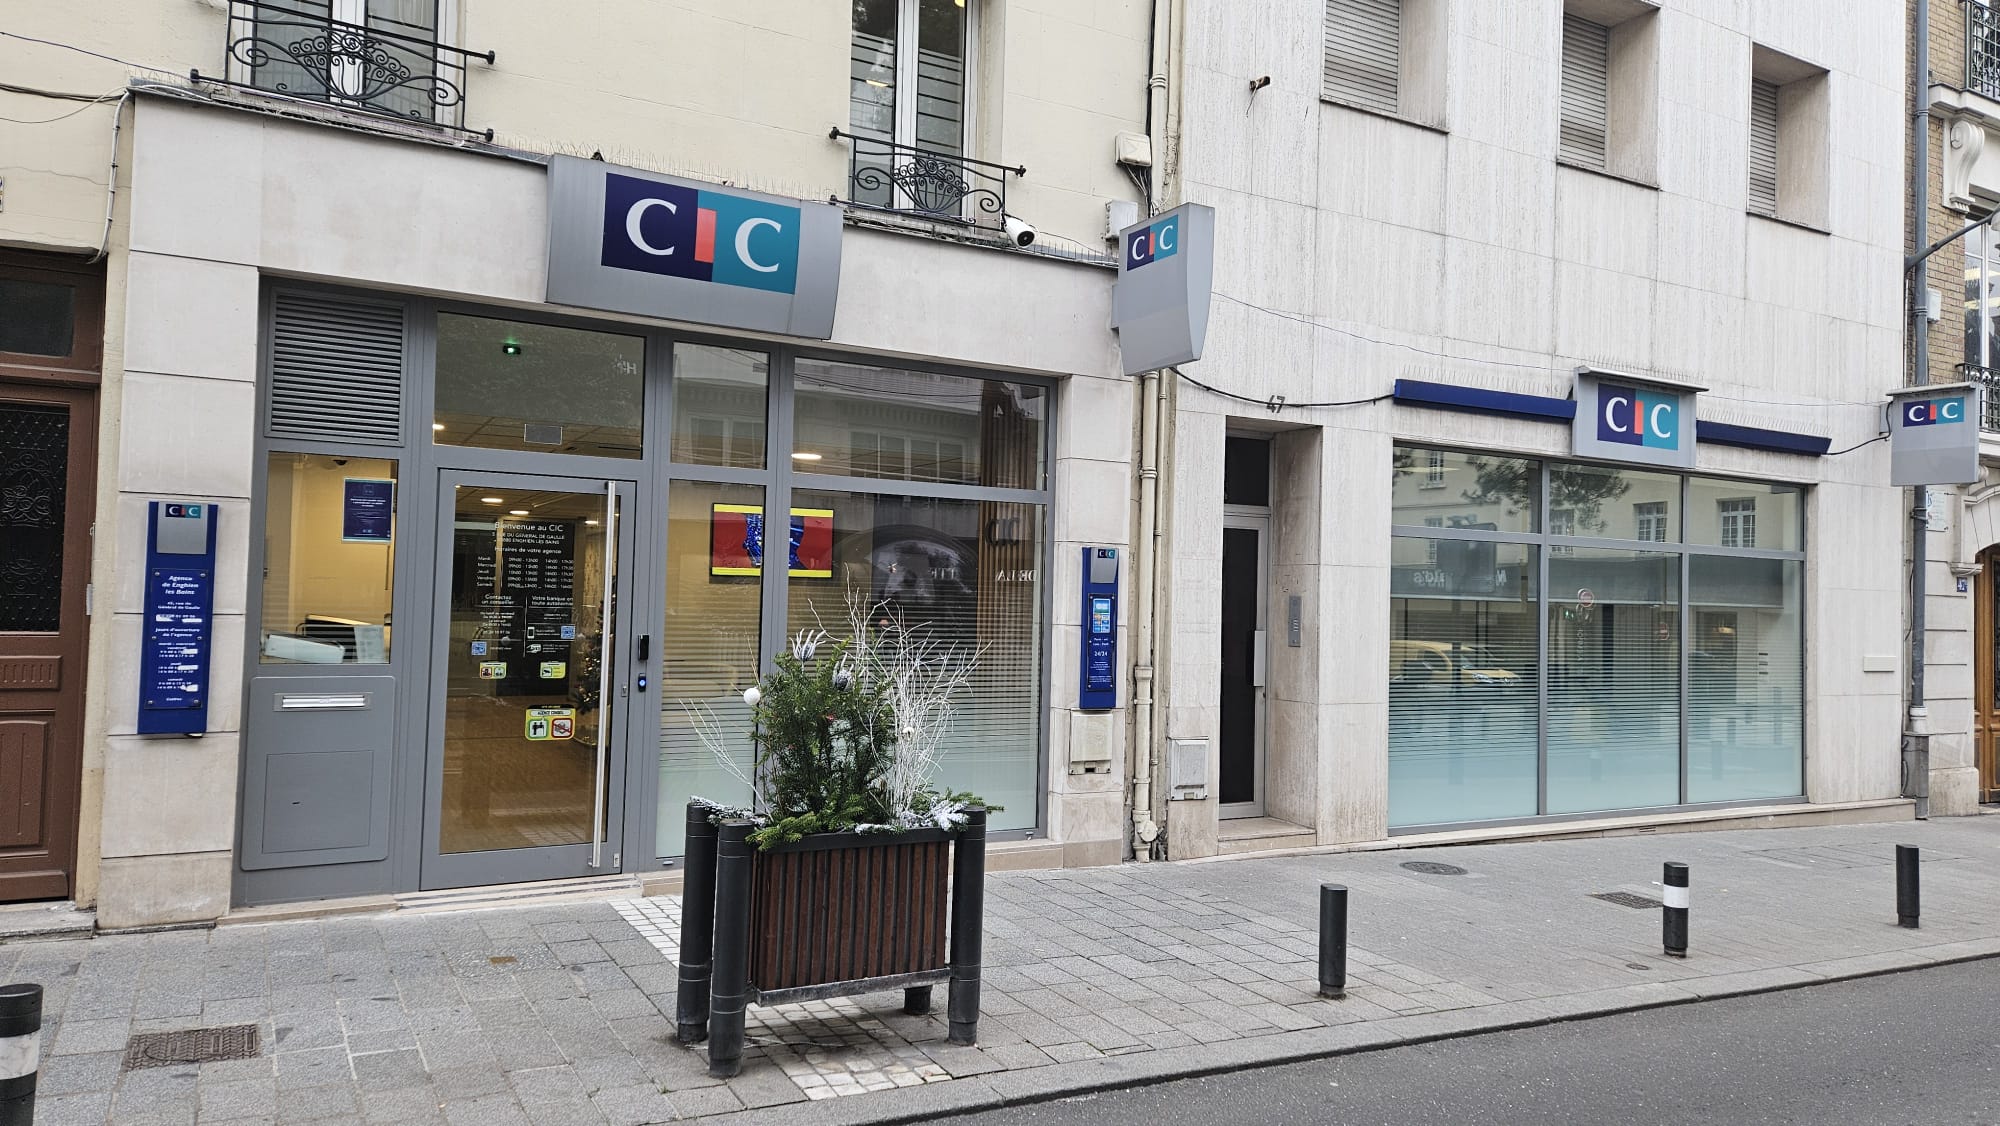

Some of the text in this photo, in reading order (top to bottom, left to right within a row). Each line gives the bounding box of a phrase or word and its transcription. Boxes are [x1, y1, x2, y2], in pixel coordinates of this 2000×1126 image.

[625, 198, 782, 273] CIC
[1132, 225, 1174, 260] CIC
[1266, 395, 1286, 413] 47
[1908, 402, 1959, 422] CIC
[1605, 396, 1672, 438] CIC
[168, 505, 199, 517] CIC
[548, 524, 564, 532] CIC
